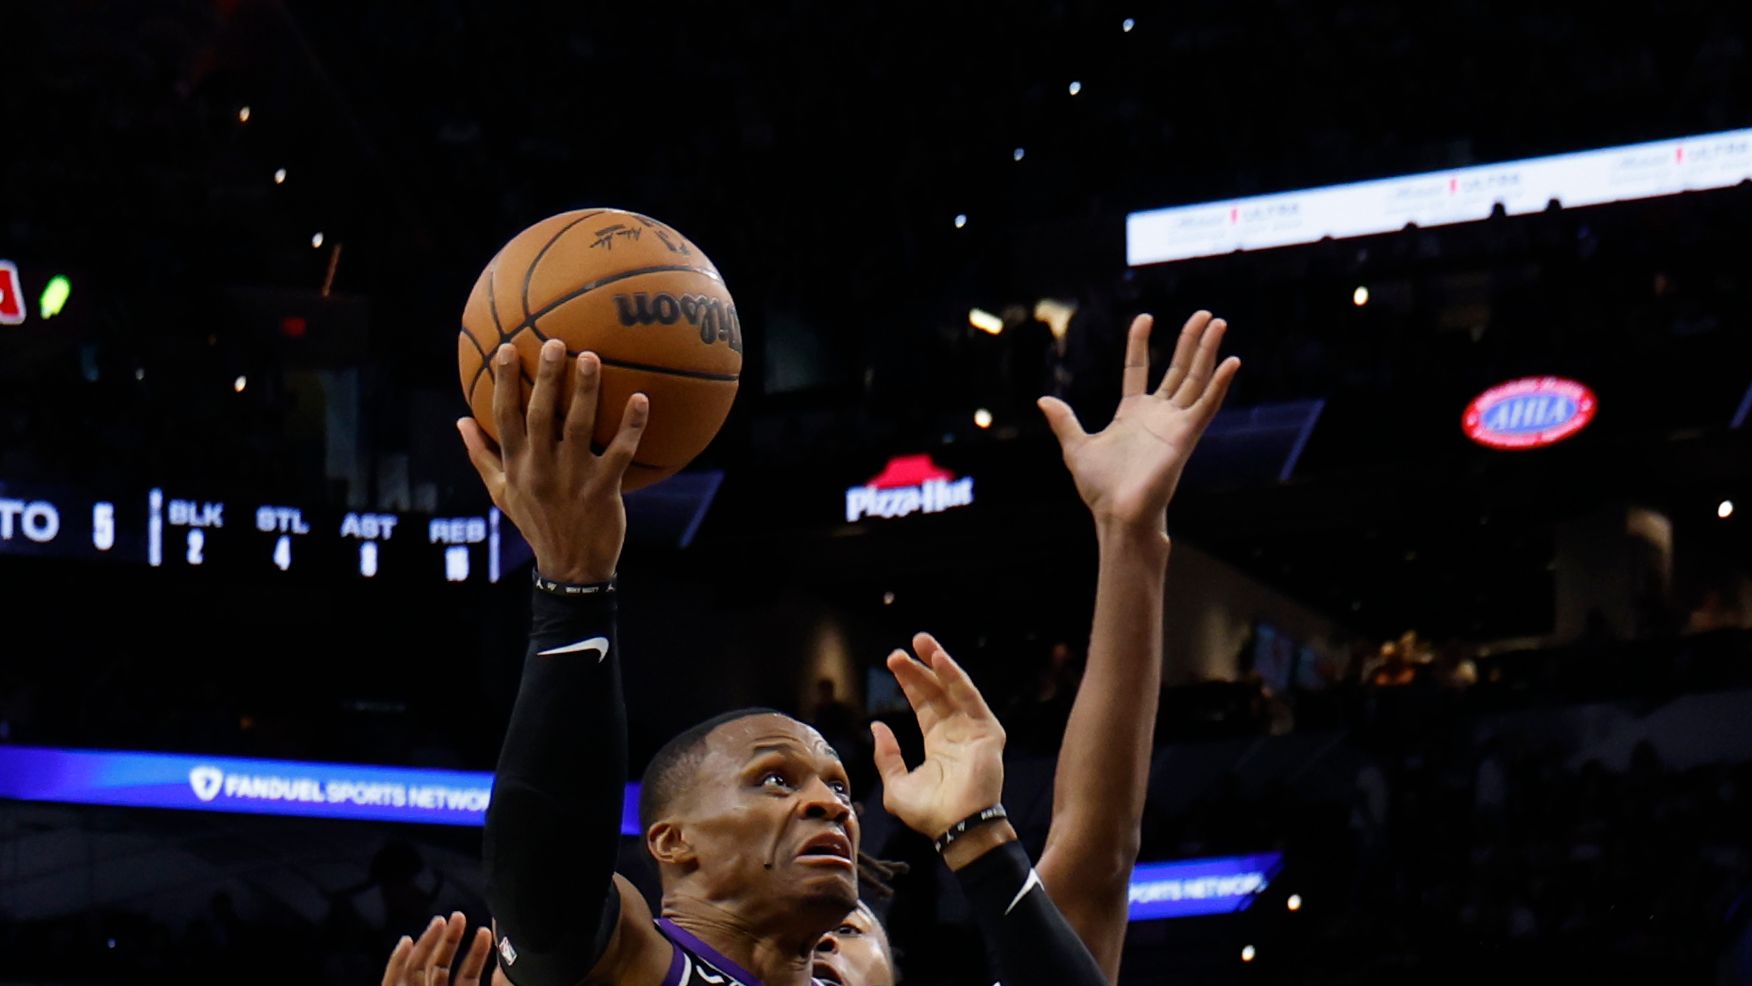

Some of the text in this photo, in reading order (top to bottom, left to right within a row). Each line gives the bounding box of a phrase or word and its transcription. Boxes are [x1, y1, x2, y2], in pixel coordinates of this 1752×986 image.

[0, 499, 60, 542] TO
[168, 499, 487, 544] BLK STL AST REB
[225, 775, 491, 812] FANDUEL SPORTS NETWOR
